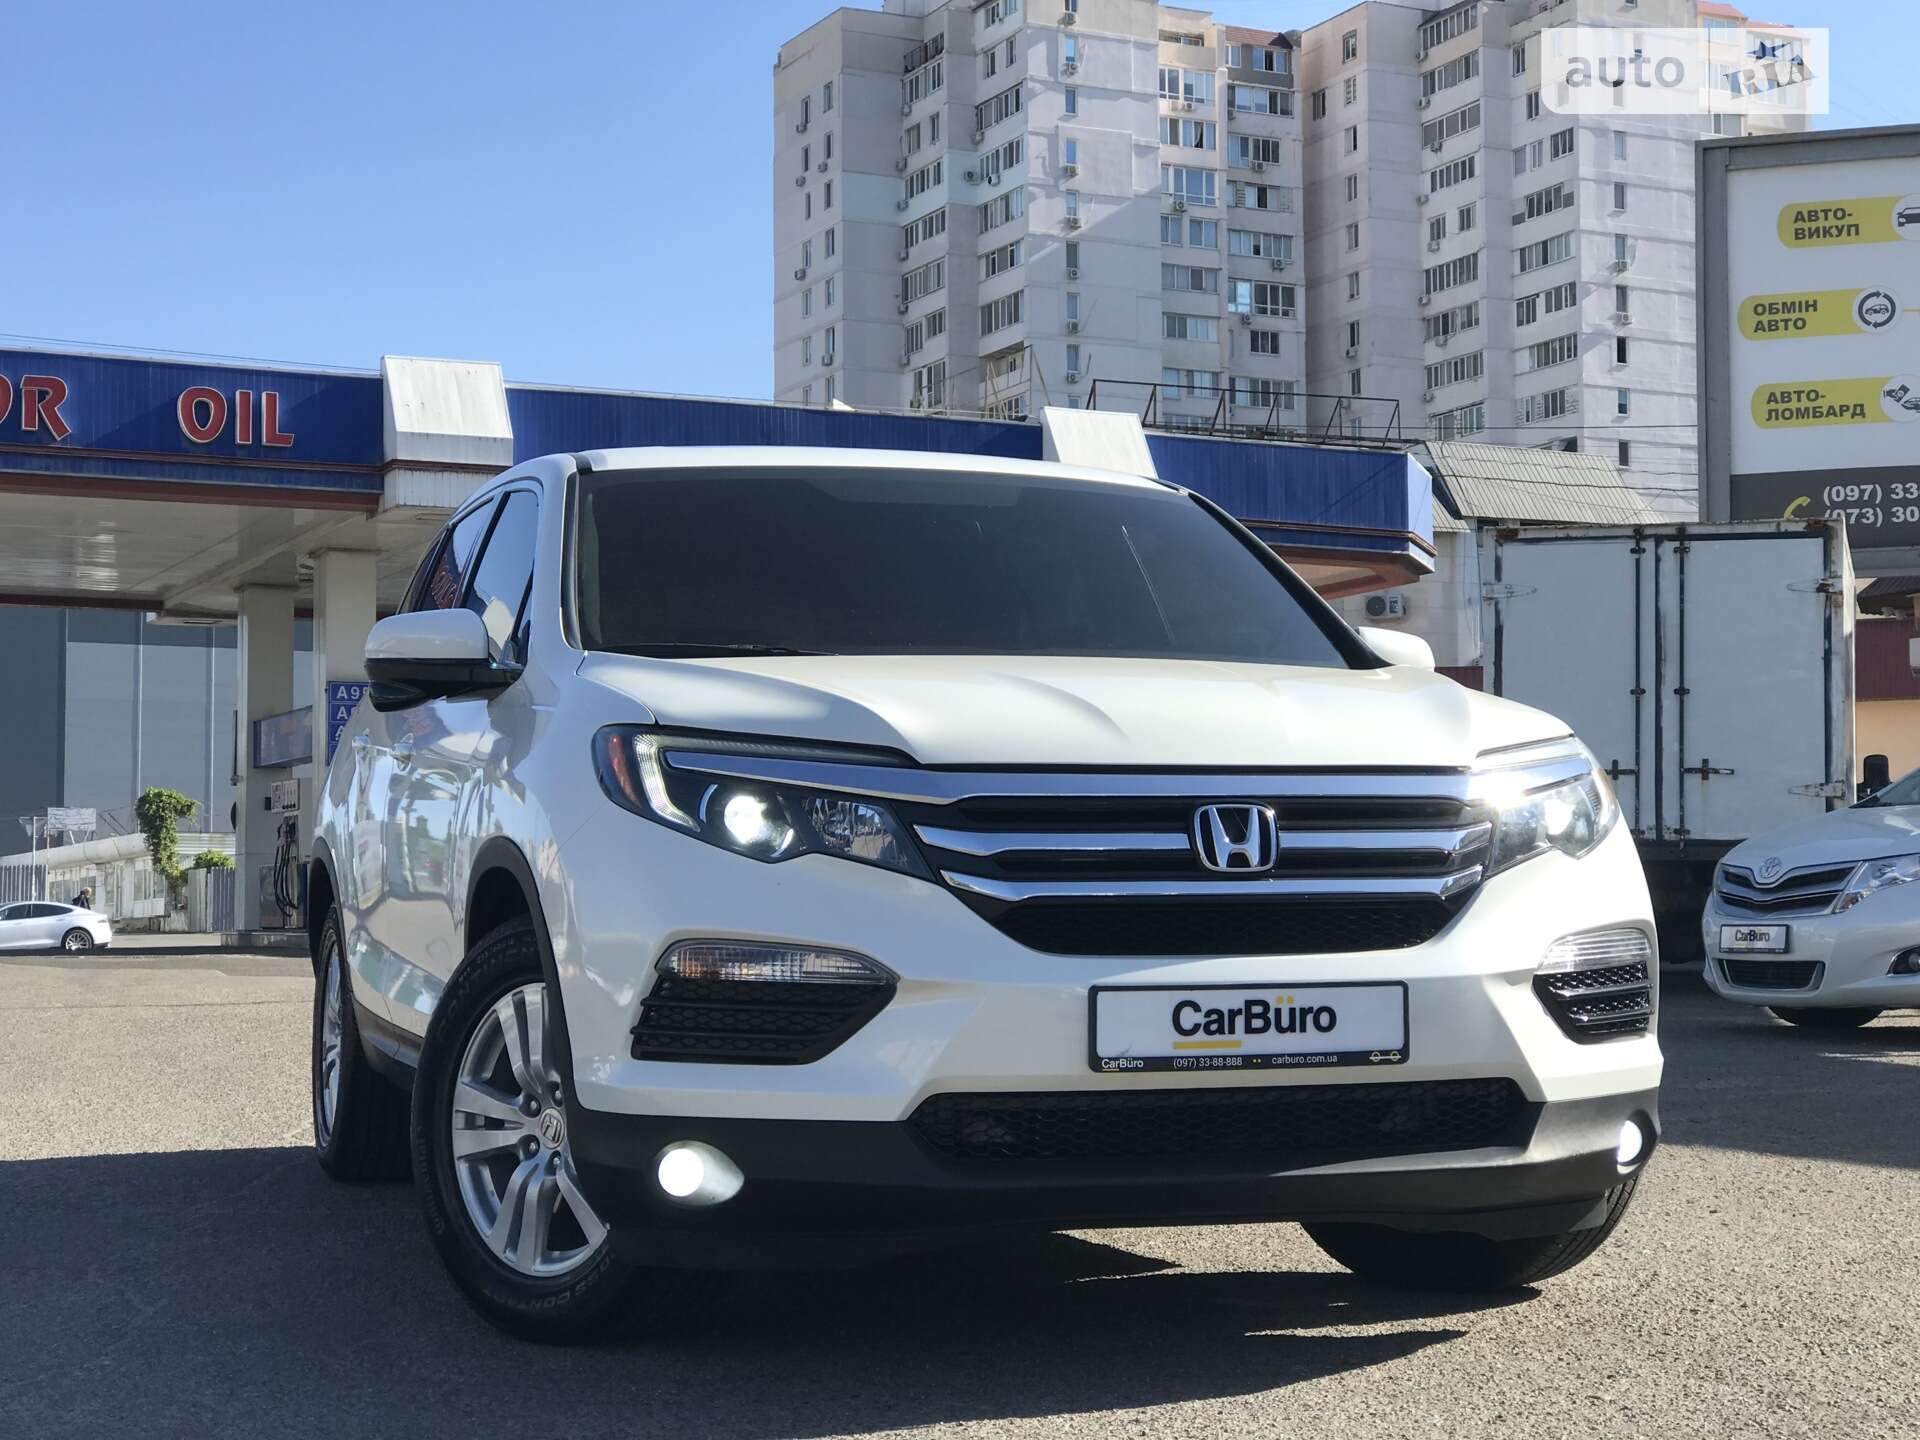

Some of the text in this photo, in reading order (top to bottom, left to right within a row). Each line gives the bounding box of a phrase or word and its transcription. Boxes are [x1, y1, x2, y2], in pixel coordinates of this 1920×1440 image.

[1793, 207, 1853, 224] АВТО-
[1794, 223, 1860, 241] ВИКУП
[1753, 299, 1818, 316] ОБМІН
[1753, 317, 1807, 333] АВТО
[1766, 389, 1826, 405] АВТО-
[0, 373, 294, 447] R OIL
[1765, 403, 1866, 422] ЛОМБАРД
[1823, 482, 1920, 506] (097) 33
[1172, 995, 1337, 1037] CarBüro
[1101, 1054, 1338, 1069] CarBüro (097) 33-88-888 carburo.com.ua
